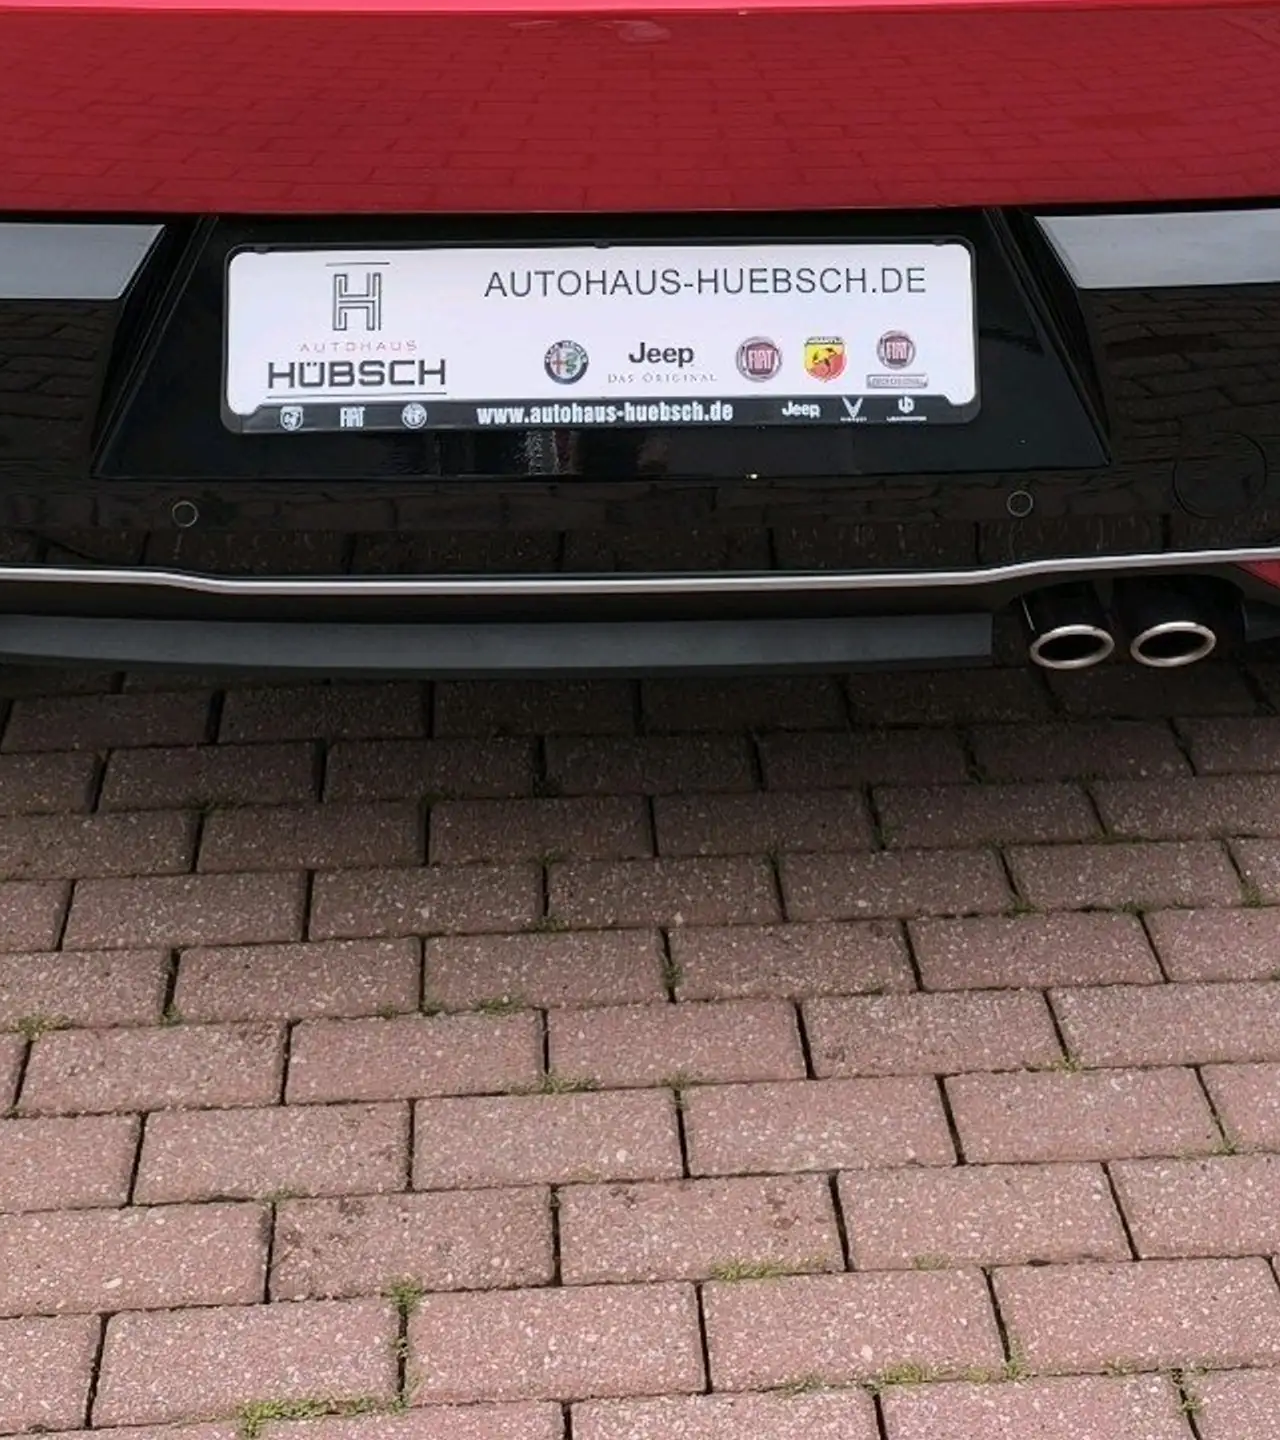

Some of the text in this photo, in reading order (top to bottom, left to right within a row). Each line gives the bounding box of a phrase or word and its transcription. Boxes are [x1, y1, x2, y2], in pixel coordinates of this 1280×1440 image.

[483, 267, 927, 298] AUTOHAUS-HUEBSCH.DE
[299, 339, 418, 353] AUTOHAUS
[628, 341, 695, 368] Jeep
[747, 349, 777, 371] FIAT
[267, 359, 447, 389] HÜBSCH
[607, 373, 635, 384] DAS
[476, 400, 734, 426] www.autohaus-huebsch.de
[781, 400, 821, 419] Jeep
